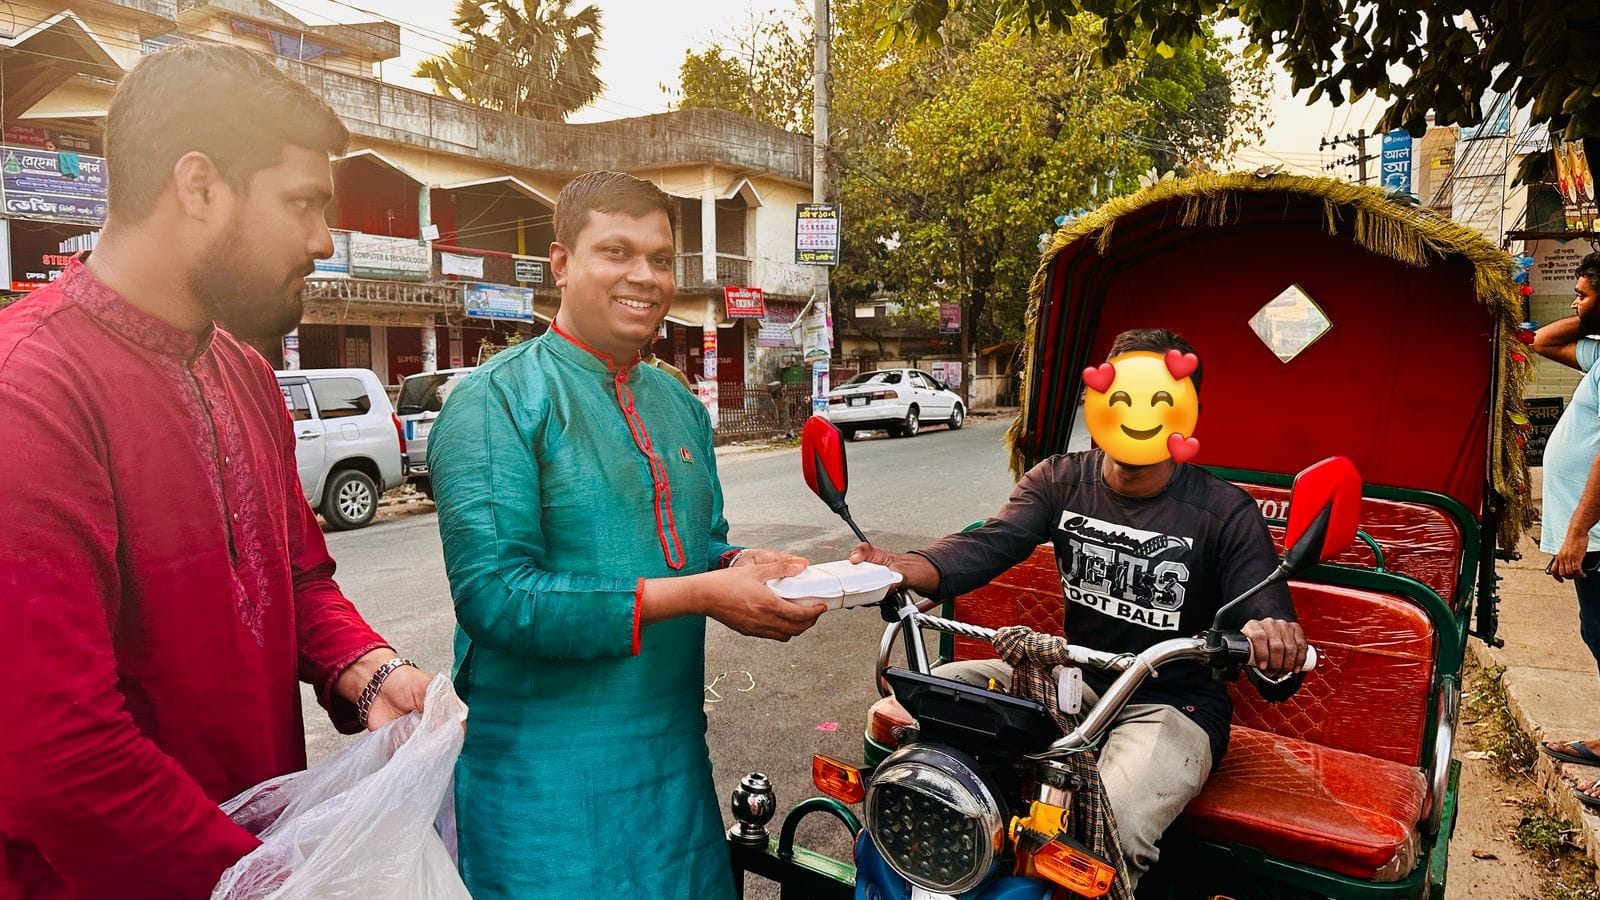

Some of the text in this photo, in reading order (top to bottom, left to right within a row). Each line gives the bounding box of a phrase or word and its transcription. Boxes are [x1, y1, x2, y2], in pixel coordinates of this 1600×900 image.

[43, 254, 70, 266] STEE
[354, 251, 383, 261] COMPUTER
[390, 255, 428, 264] TECHNOLOGIES
[1117, 602, 1175, 628] BALL
